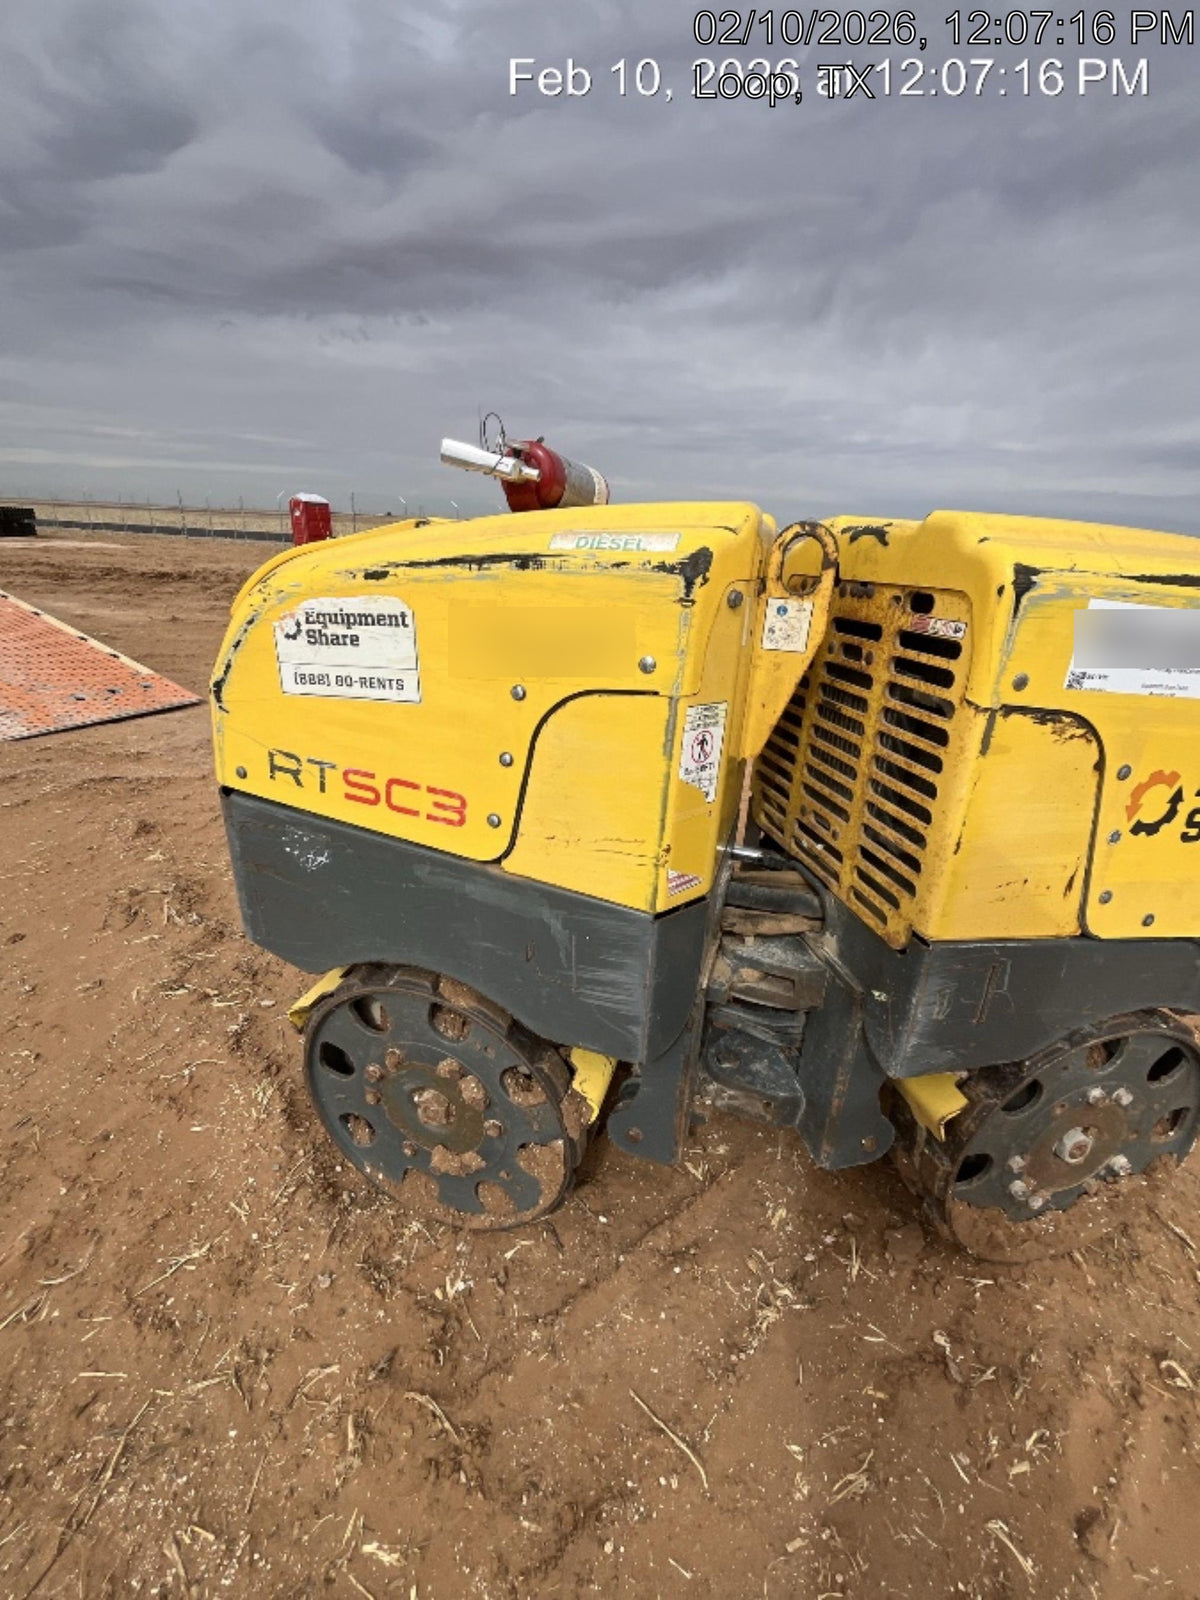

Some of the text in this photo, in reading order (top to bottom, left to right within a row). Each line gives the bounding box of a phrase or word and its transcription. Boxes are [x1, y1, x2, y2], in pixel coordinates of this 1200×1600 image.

[575, 533, 648, 552] DIESEL
[304, 608, 410, 631] Equipment
[306, 628, 361, 647] Share
[268, 748, 468, 828] RTSC3
